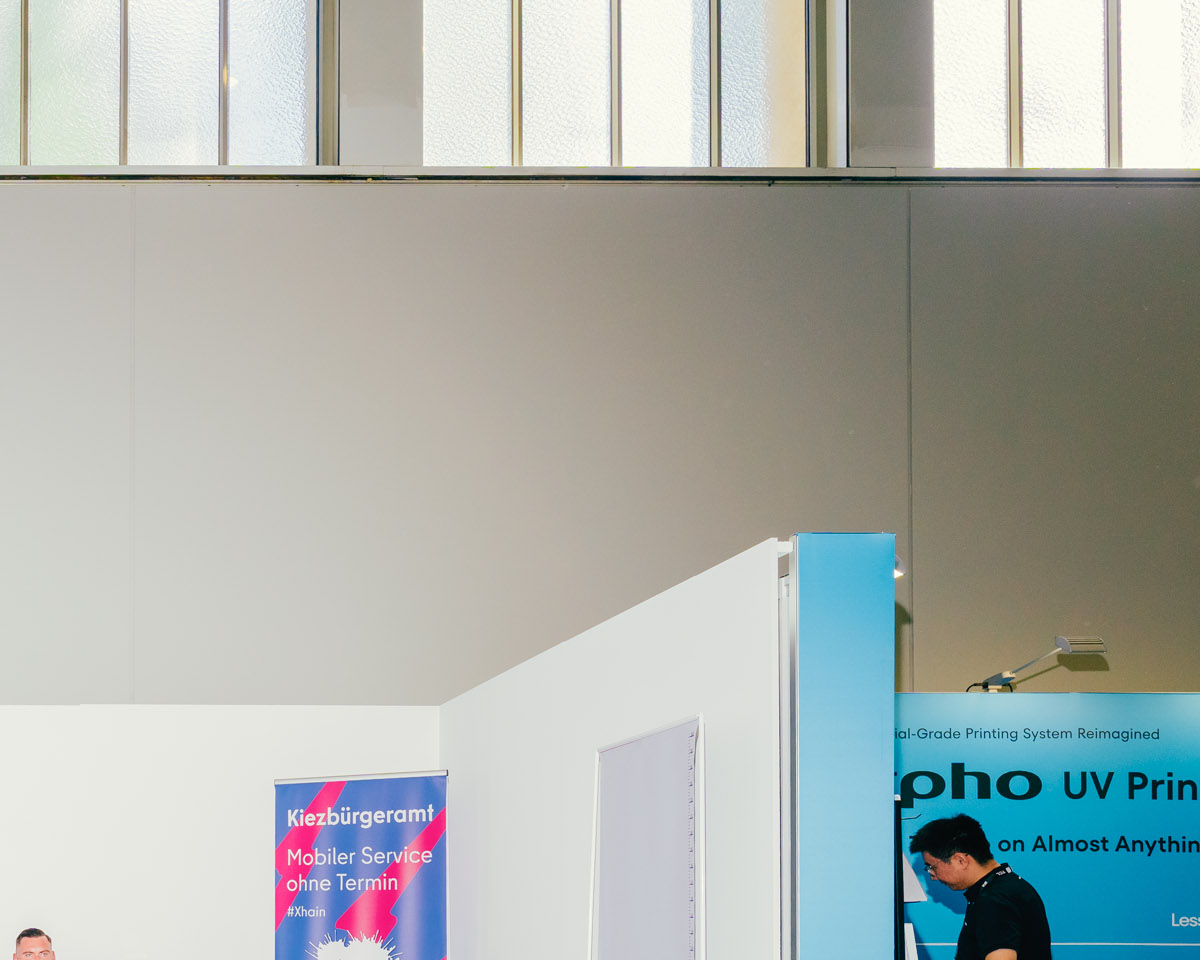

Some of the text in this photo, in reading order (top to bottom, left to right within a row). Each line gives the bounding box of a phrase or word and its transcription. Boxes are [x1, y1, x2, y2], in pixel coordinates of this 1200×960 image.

[894, 728, 1160, 742] ial-Grade Printing System Reimagined
[894, 763, 1042, 808] pho
[1064, 772, 1114, 800] UV
[287, 804, 434, 829] Kiezbürgeramt
[998, 839, 1025, 852] on
[1032, 836, 1109, 852] Almost
[287, 846, 433, 866] Mobiler Service
[287, 873, 398, 892] ohne Termin
[287, 905, 326, 918] #Xhain
